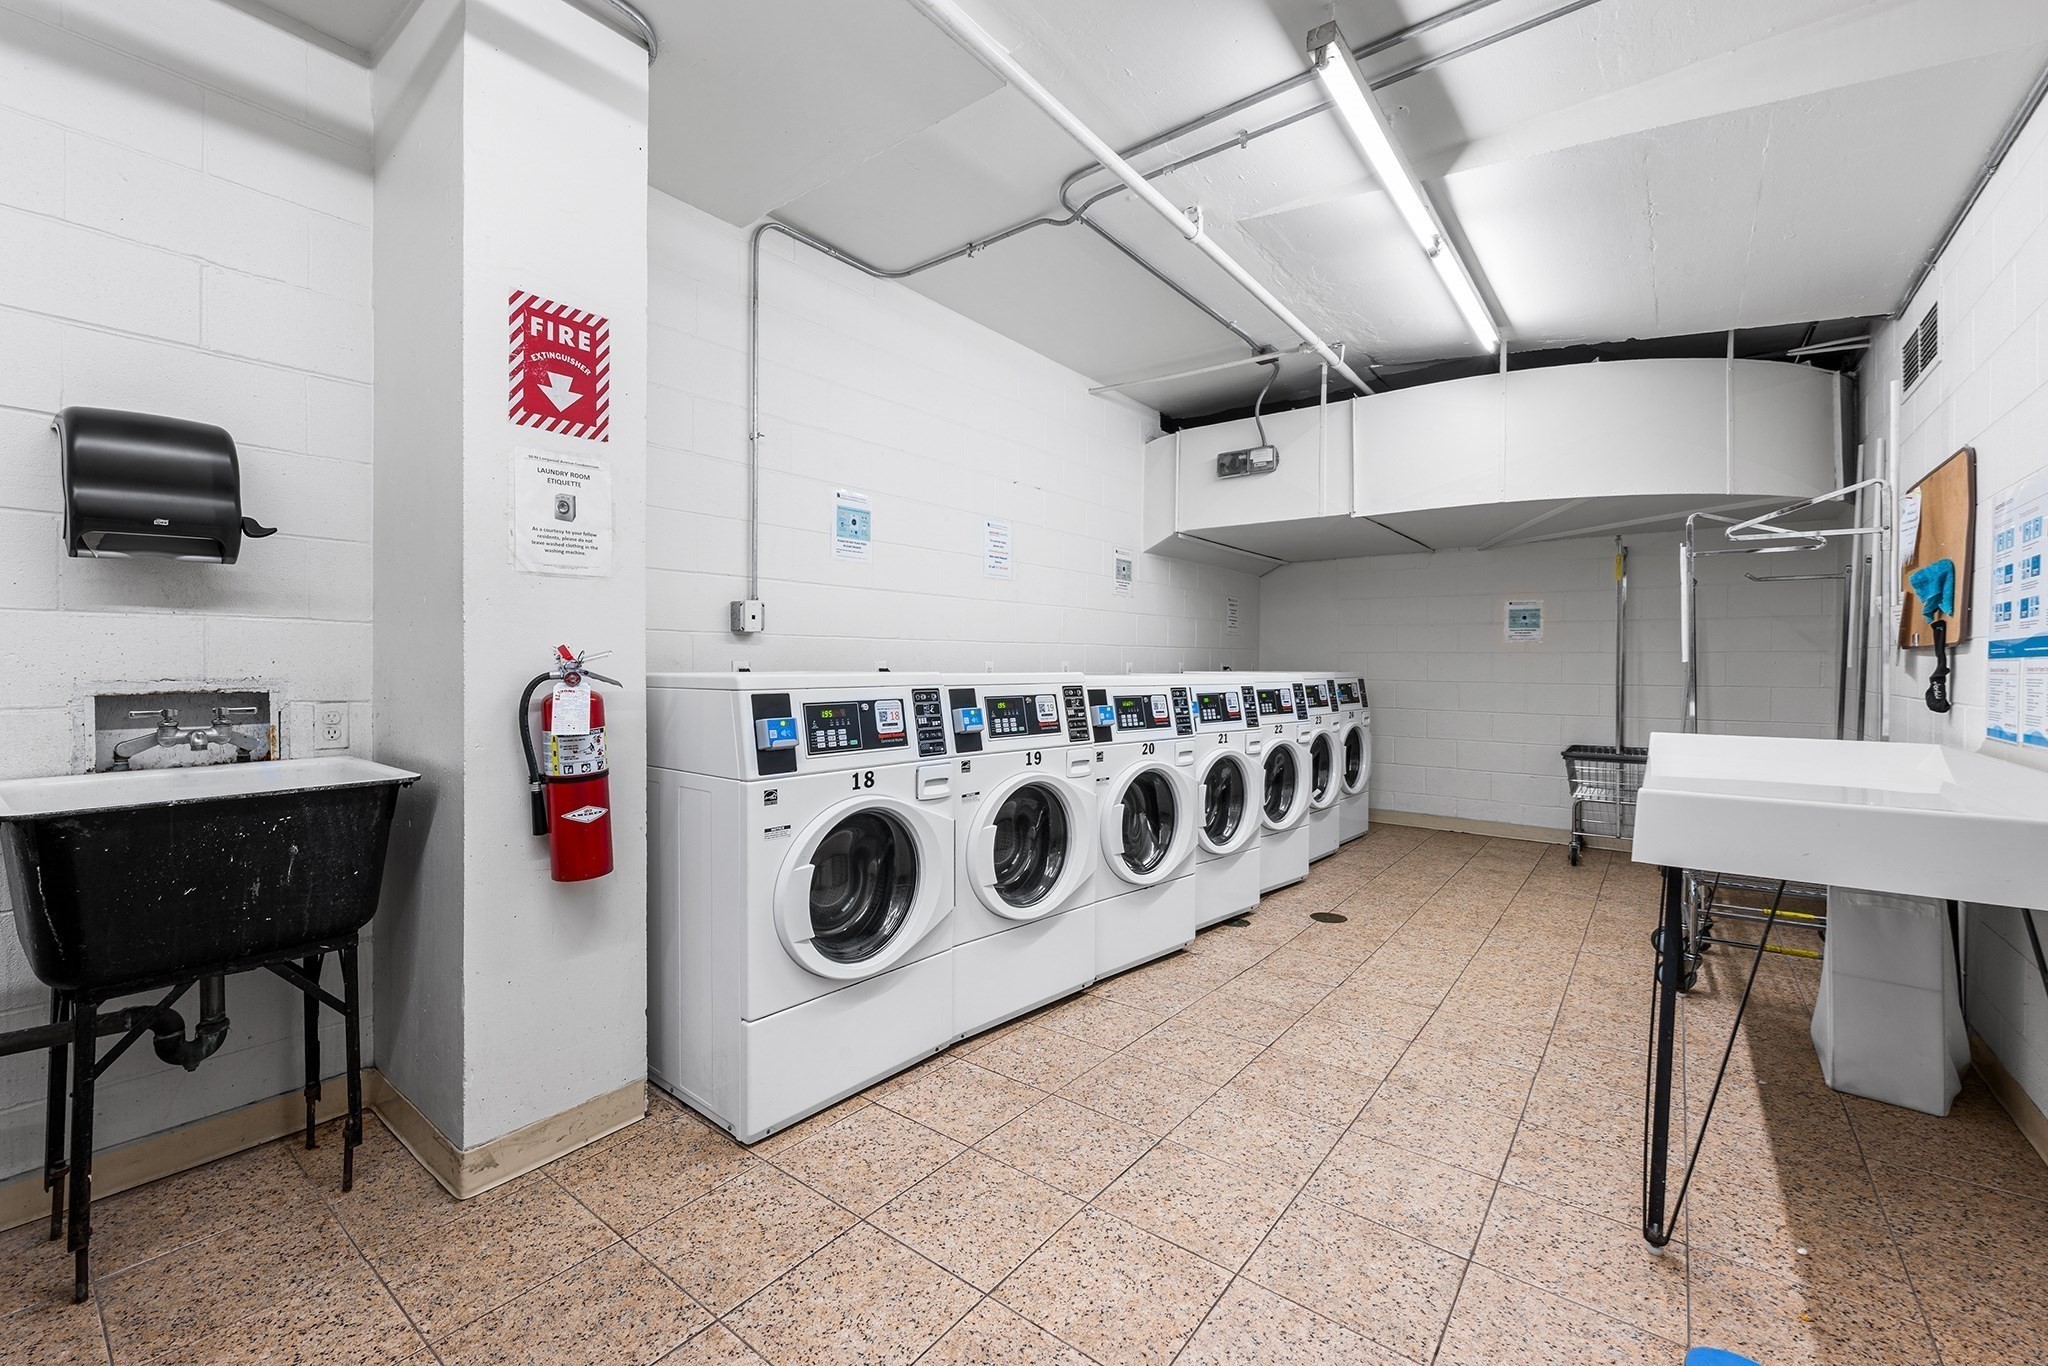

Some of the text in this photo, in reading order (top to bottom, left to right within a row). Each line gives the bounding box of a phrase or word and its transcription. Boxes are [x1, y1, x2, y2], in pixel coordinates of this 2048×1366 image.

[531, 316, 591, 352] FIRE
[530, 351, 591, 376] EXTINGUISHER
[537, 467, 591, 481] LAUNDRY ROOM
[547, 478, 582, 489] ETIQUETTE
[543, 528, 564, 536] courtesy
[537, 534, 561, 542] residents,
[562, 536, 577, 544] please
[1047, 703, 1054, 712] 19
[890, 711, 900, 721] 18
[1315, 716, 1322, 725] 23
[1348, 711, 1354, 719] 24
[1274, 724, 1283, 734] 22
[1217, 733, 1228, 744] 21
[1141, 742, 1155, 756] 20
[1025, 751, 1042, 767] 19
[852, 770, 875, 791] 18
